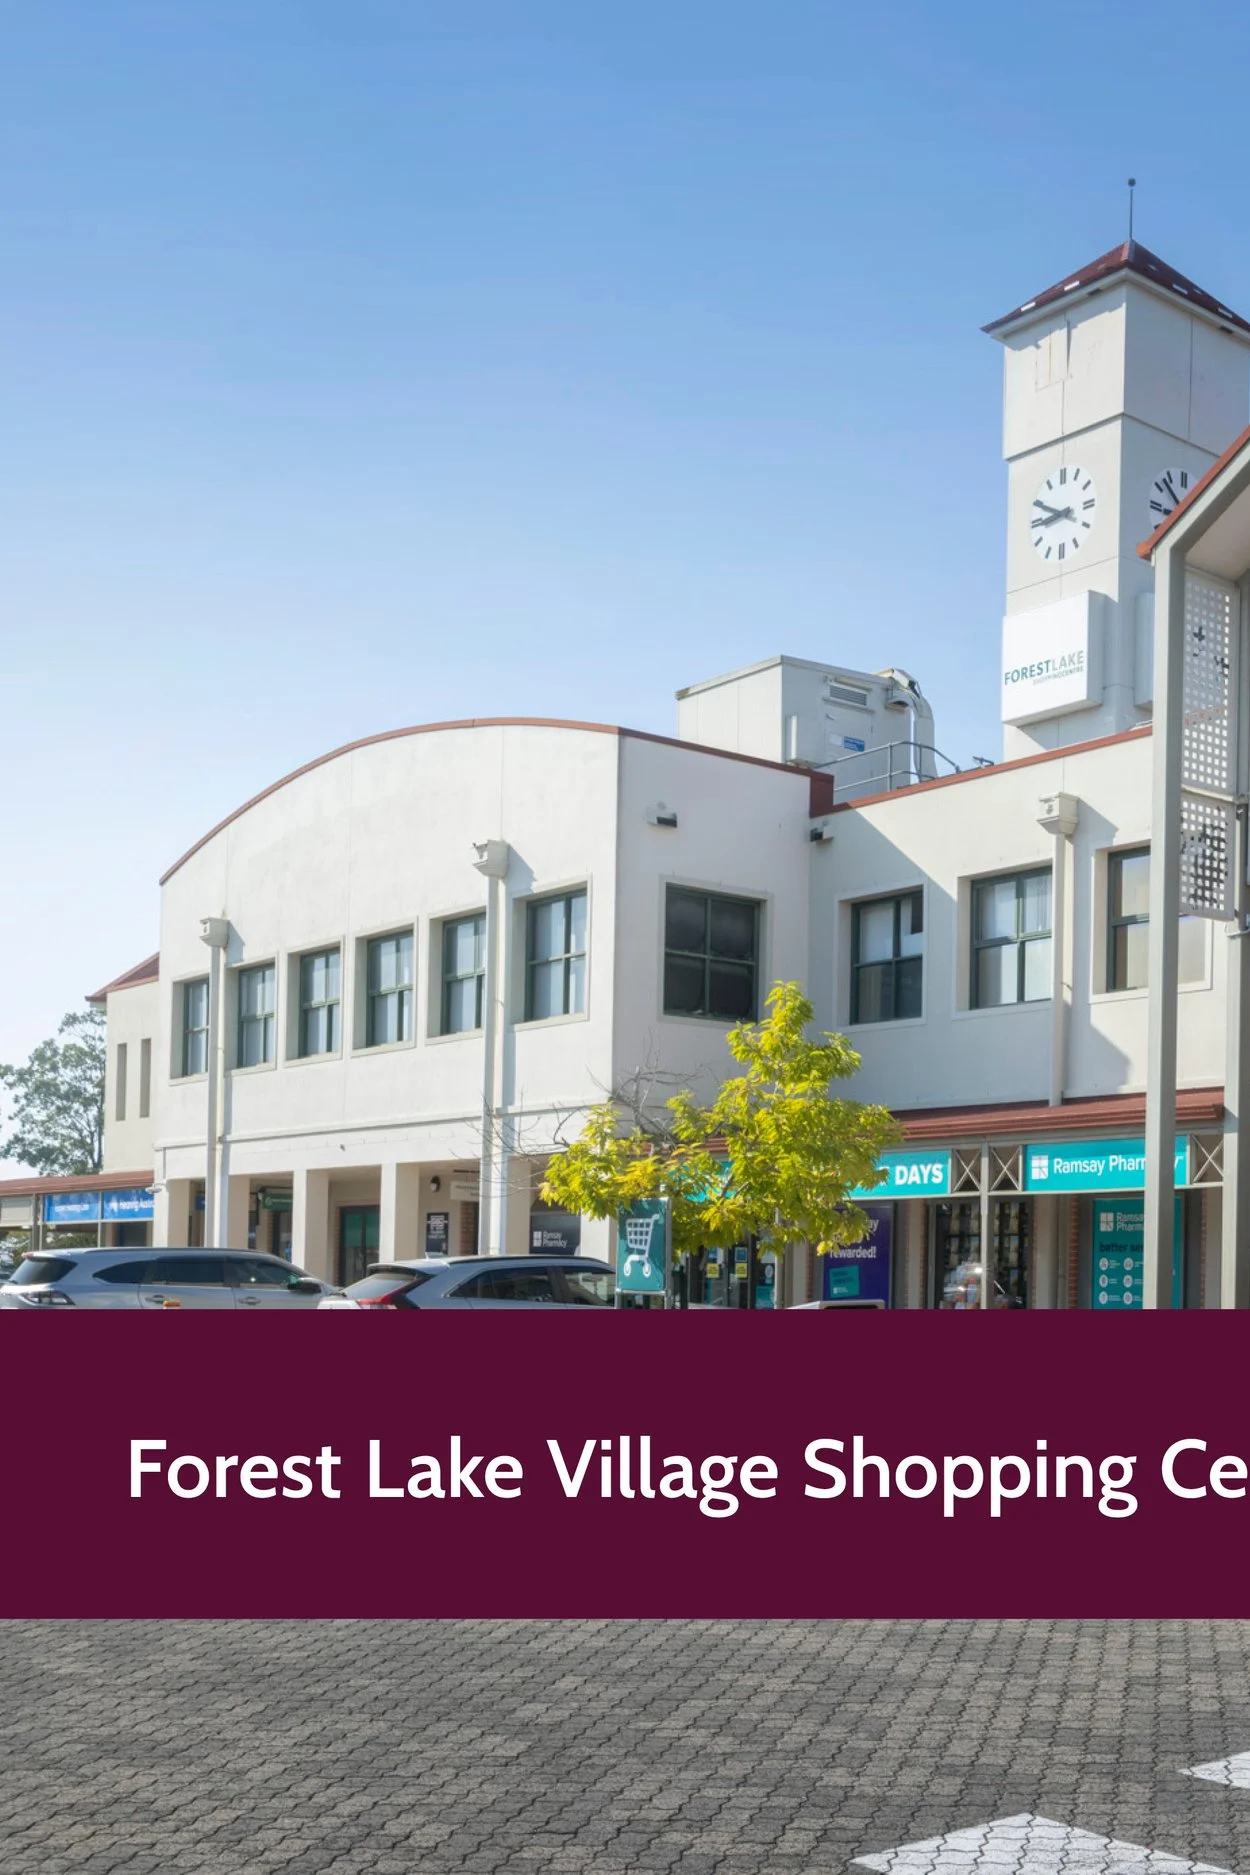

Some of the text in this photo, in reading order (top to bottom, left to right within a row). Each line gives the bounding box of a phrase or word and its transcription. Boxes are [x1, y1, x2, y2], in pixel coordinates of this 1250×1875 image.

[1053, 1157, 1106, 1177] Ramsay
[894, 1163, 944, 1187] DAYS
[1116, 1212, 1144, 1222] Ramsa
[1099, 1242, 1129, 1253] better
